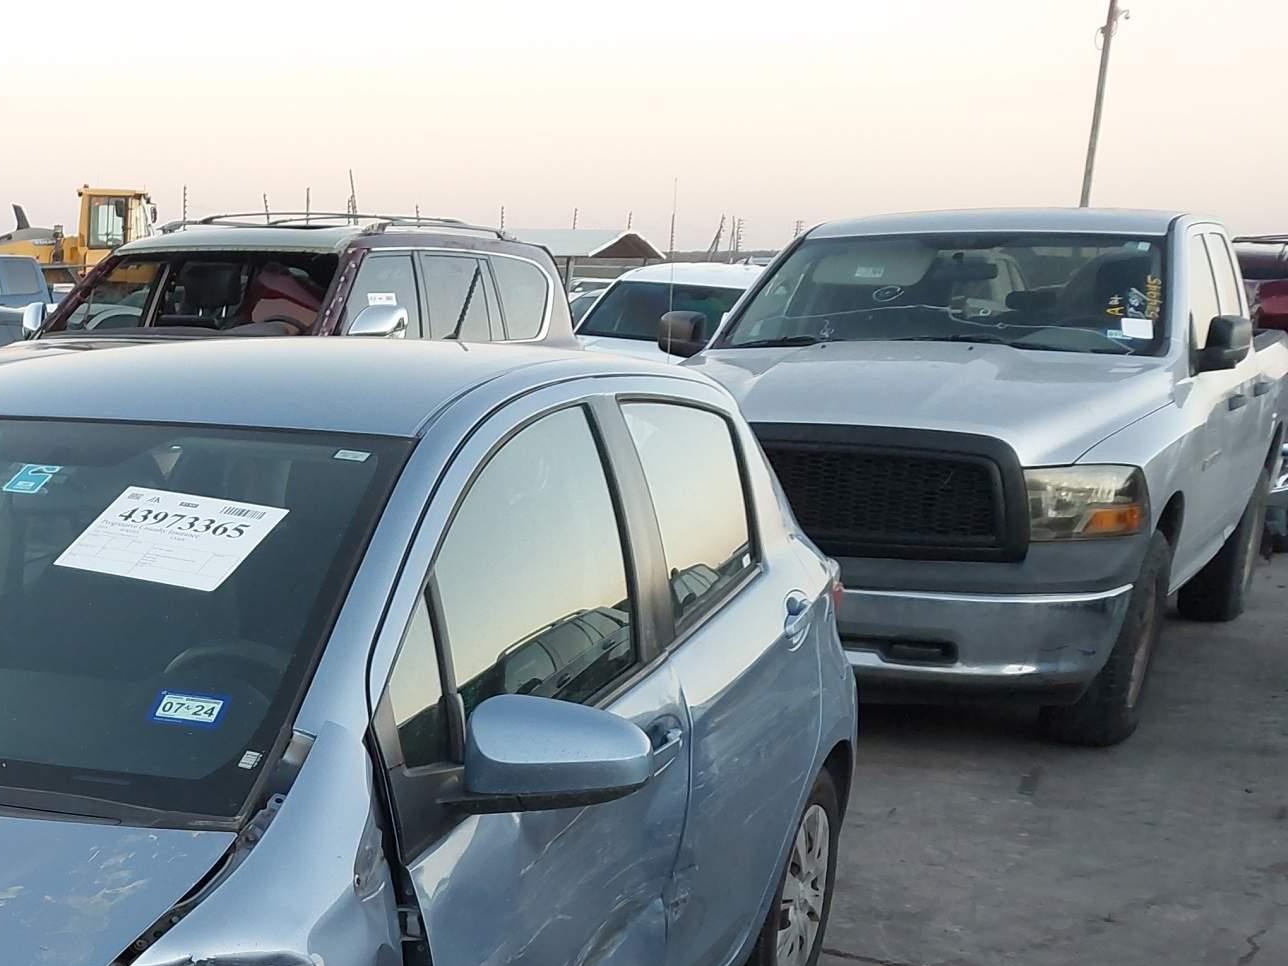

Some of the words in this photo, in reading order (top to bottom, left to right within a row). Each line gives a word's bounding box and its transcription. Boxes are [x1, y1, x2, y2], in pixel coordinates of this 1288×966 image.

[118, 506, 252, 539] 43973365
[161, 701, 187, 714] 07
[191, 704, 217, 718] 24
